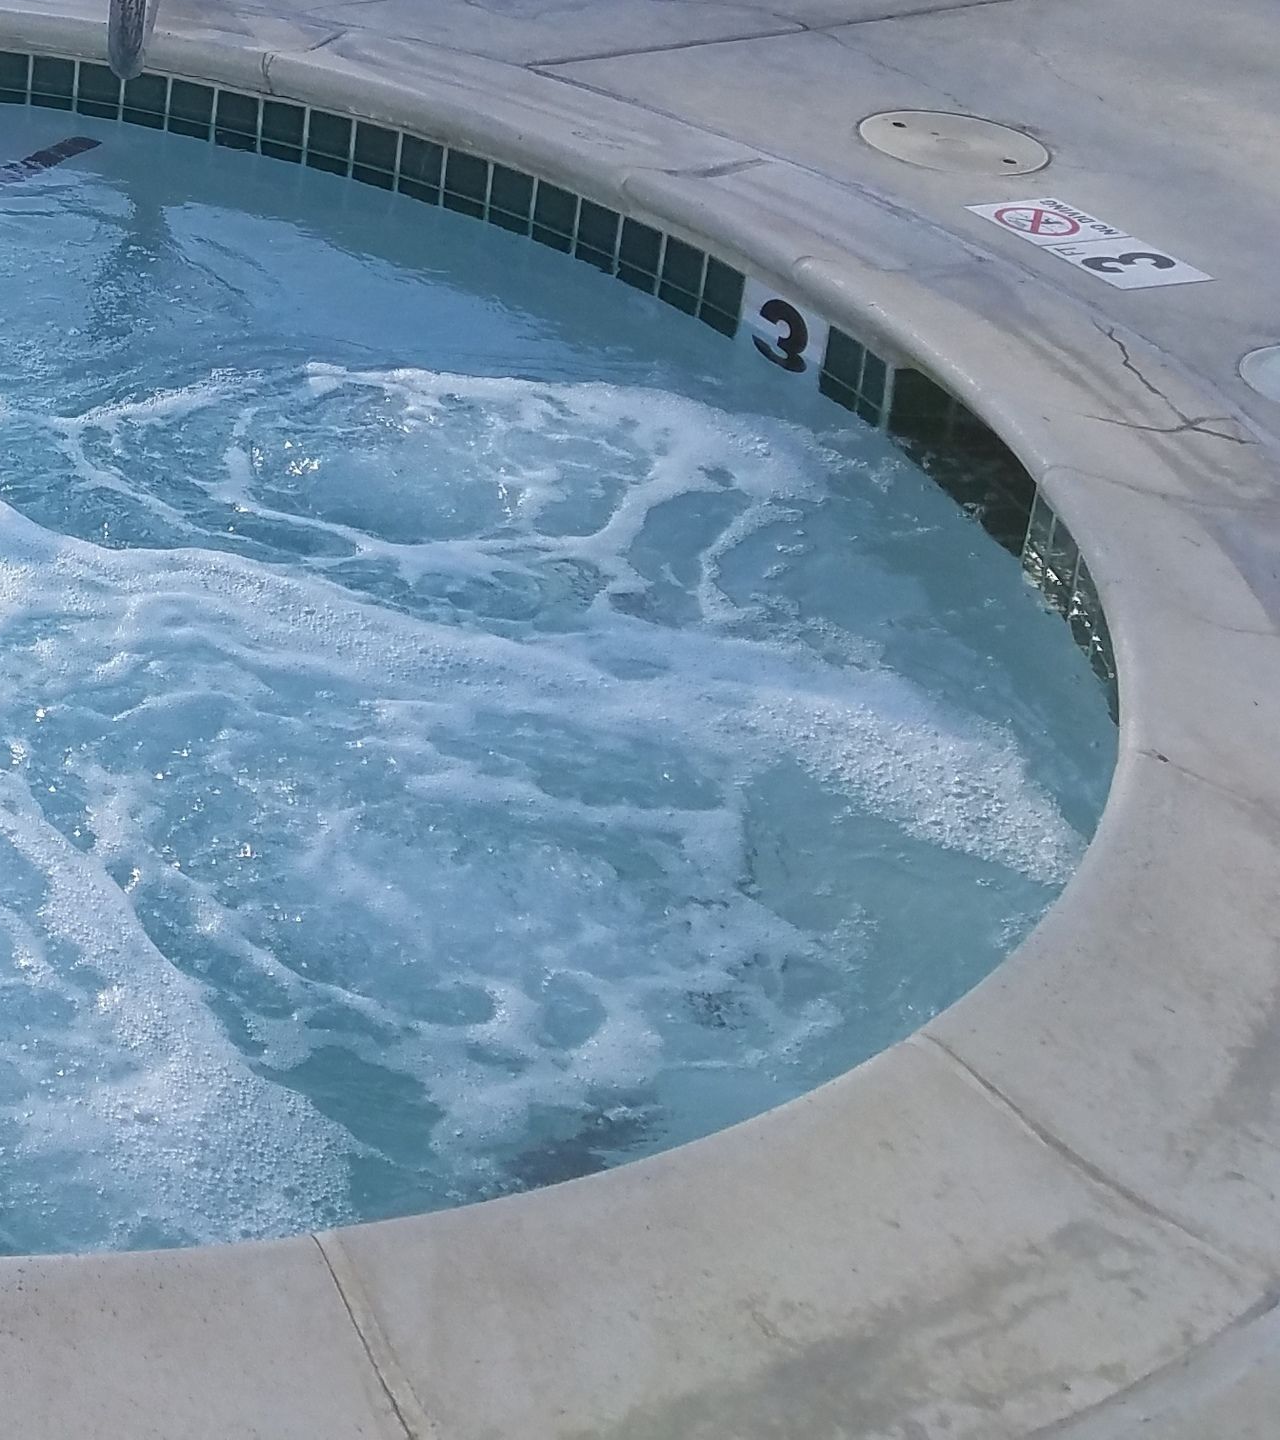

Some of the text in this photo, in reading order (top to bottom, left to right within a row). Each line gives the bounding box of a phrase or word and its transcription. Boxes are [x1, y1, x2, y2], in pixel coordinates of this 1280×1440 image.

[1040, 200, 1097, 224] DIVING
[1089, 224, 1121, 236] NO
[1053, 247, 1177, 274] 3 FT
[751, 298, 809, 374] 3
